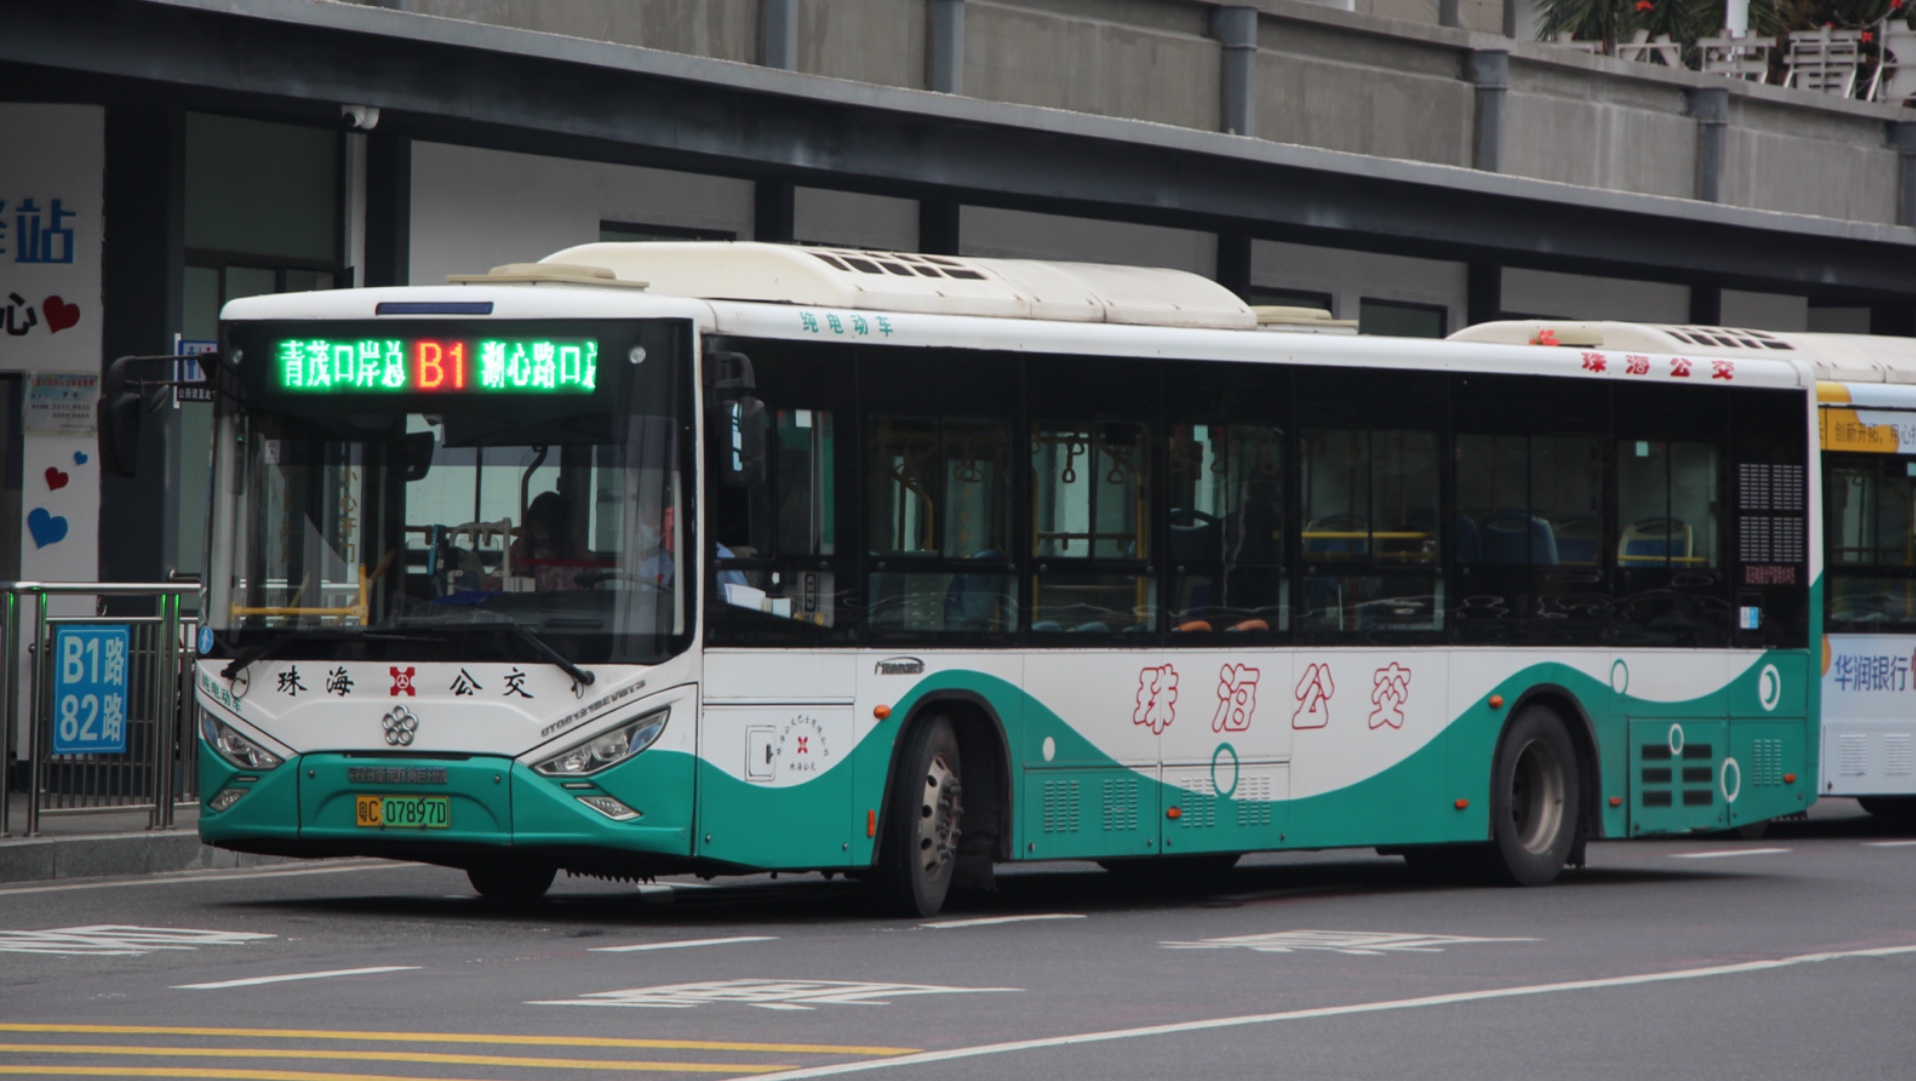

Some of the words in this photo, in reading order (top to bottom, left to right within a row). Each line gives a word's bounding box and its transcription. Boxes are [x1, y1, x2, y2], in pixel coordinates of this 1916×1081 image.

[800, 311, 893, 337] 纯电动车
[281, 340, 405, 387] 青茂口岸总
[419, 342, 463, 387] B1
[1581, 352, 1734, 380] 珠海公交
[63, 636, 125, 686] B1路
[1834, 655, 1908, 692] 华润银行
[60, 693, 123, 742] 82路
[1133, 662, 1412, 735] 珠海公交
